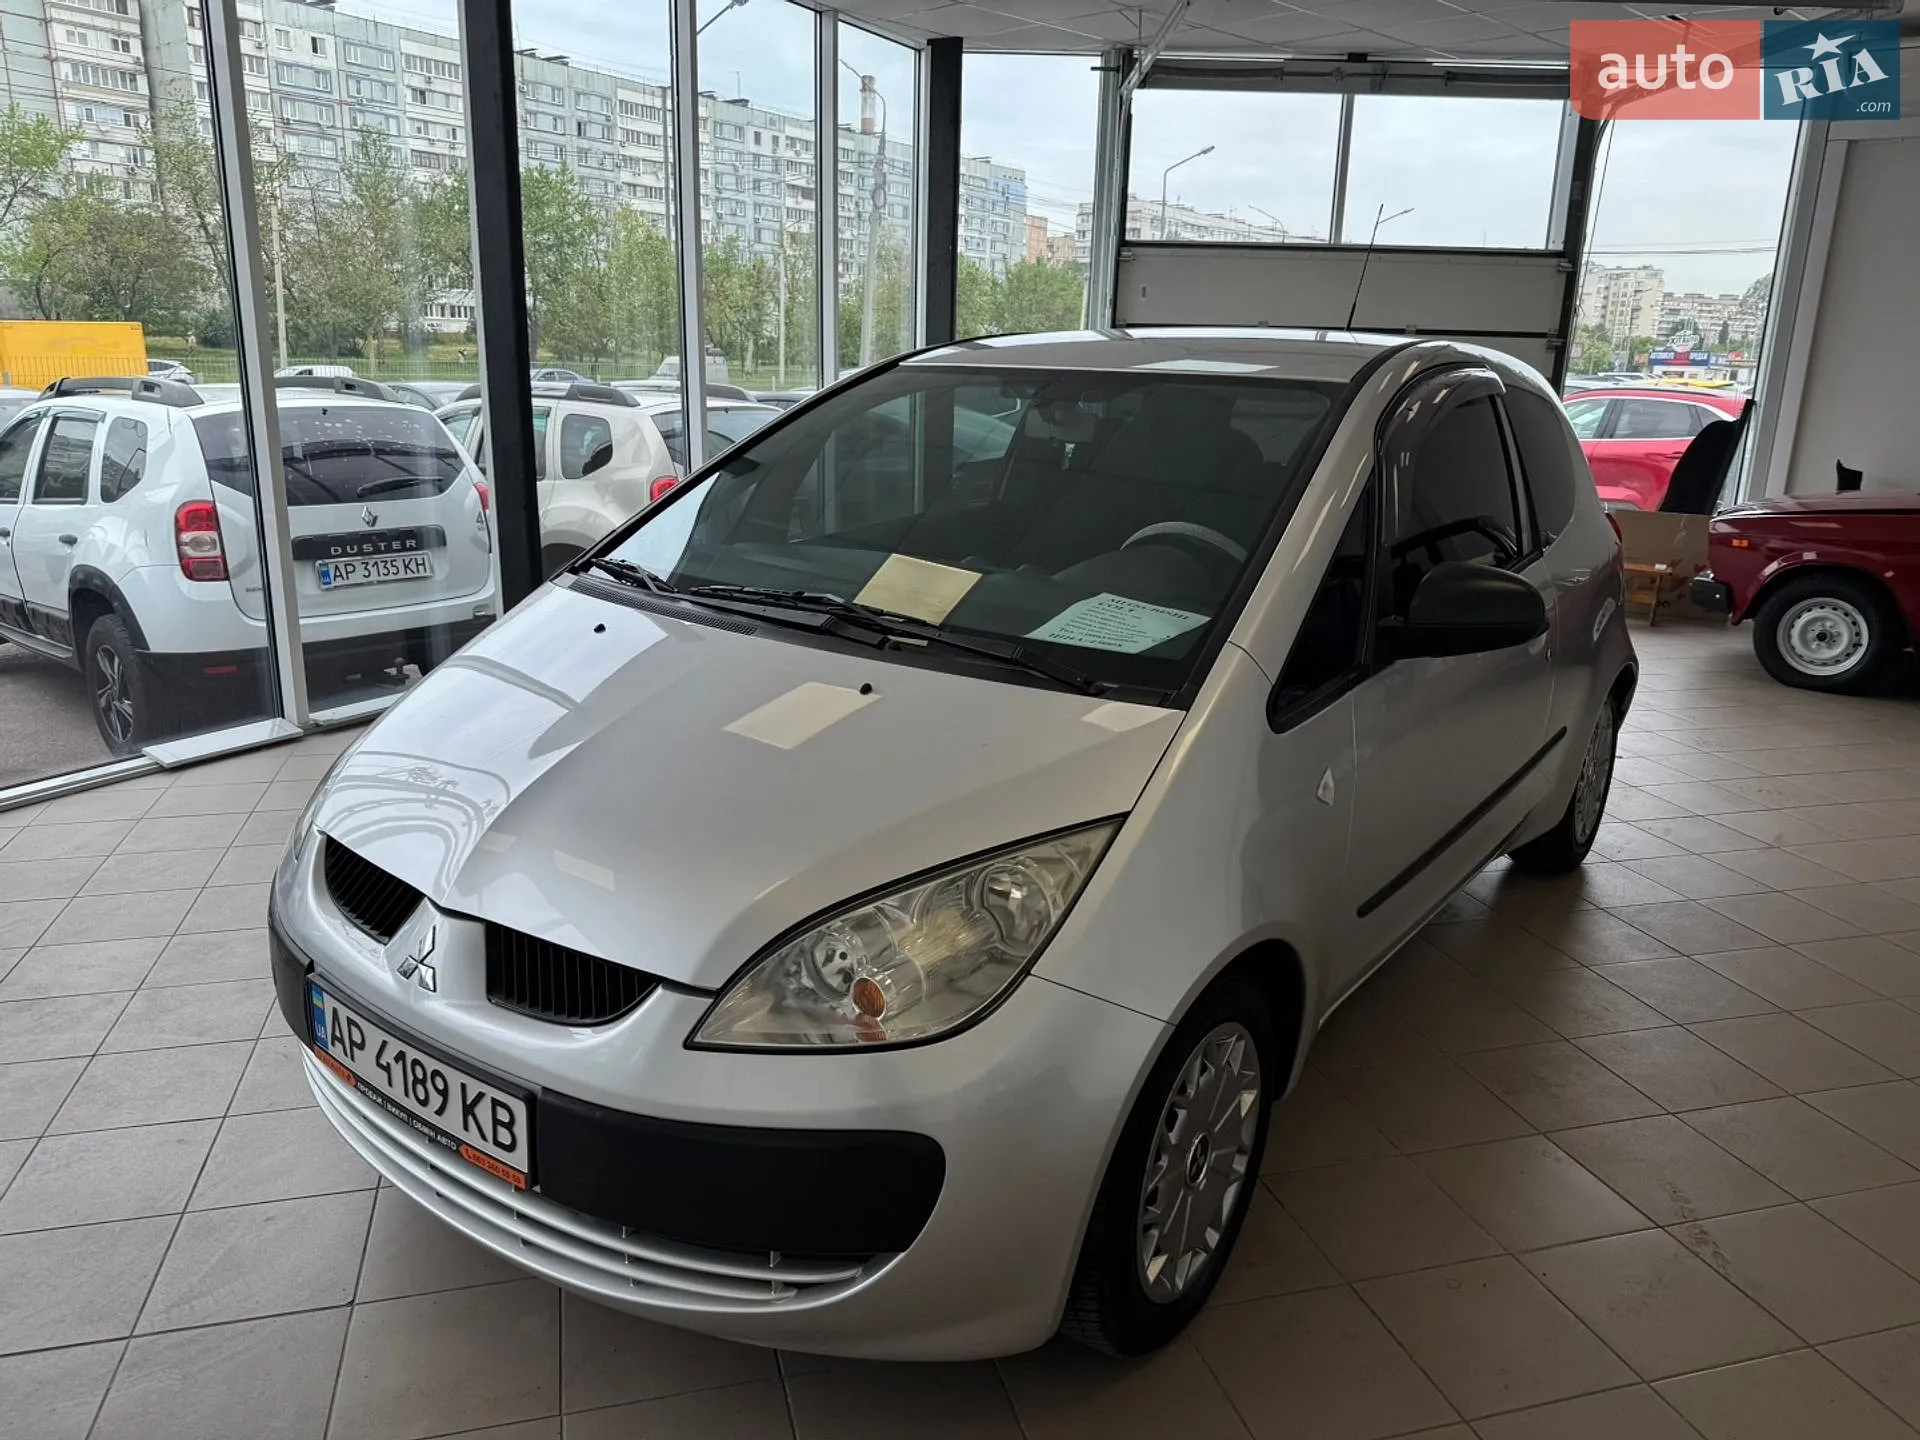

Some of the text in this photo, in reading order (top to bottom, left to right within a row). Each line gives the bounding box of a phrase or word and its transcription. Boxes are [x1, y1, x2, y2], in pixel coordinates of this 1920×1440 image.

[330, 539, 417, 555] DUSTER
[333, 557, 427, 582] AP 3135 KH
[330, 1006, 366, 1063] AP
[375, 1039, 449, 1117] 4189
[460, 1081, 517, 1153] KB
